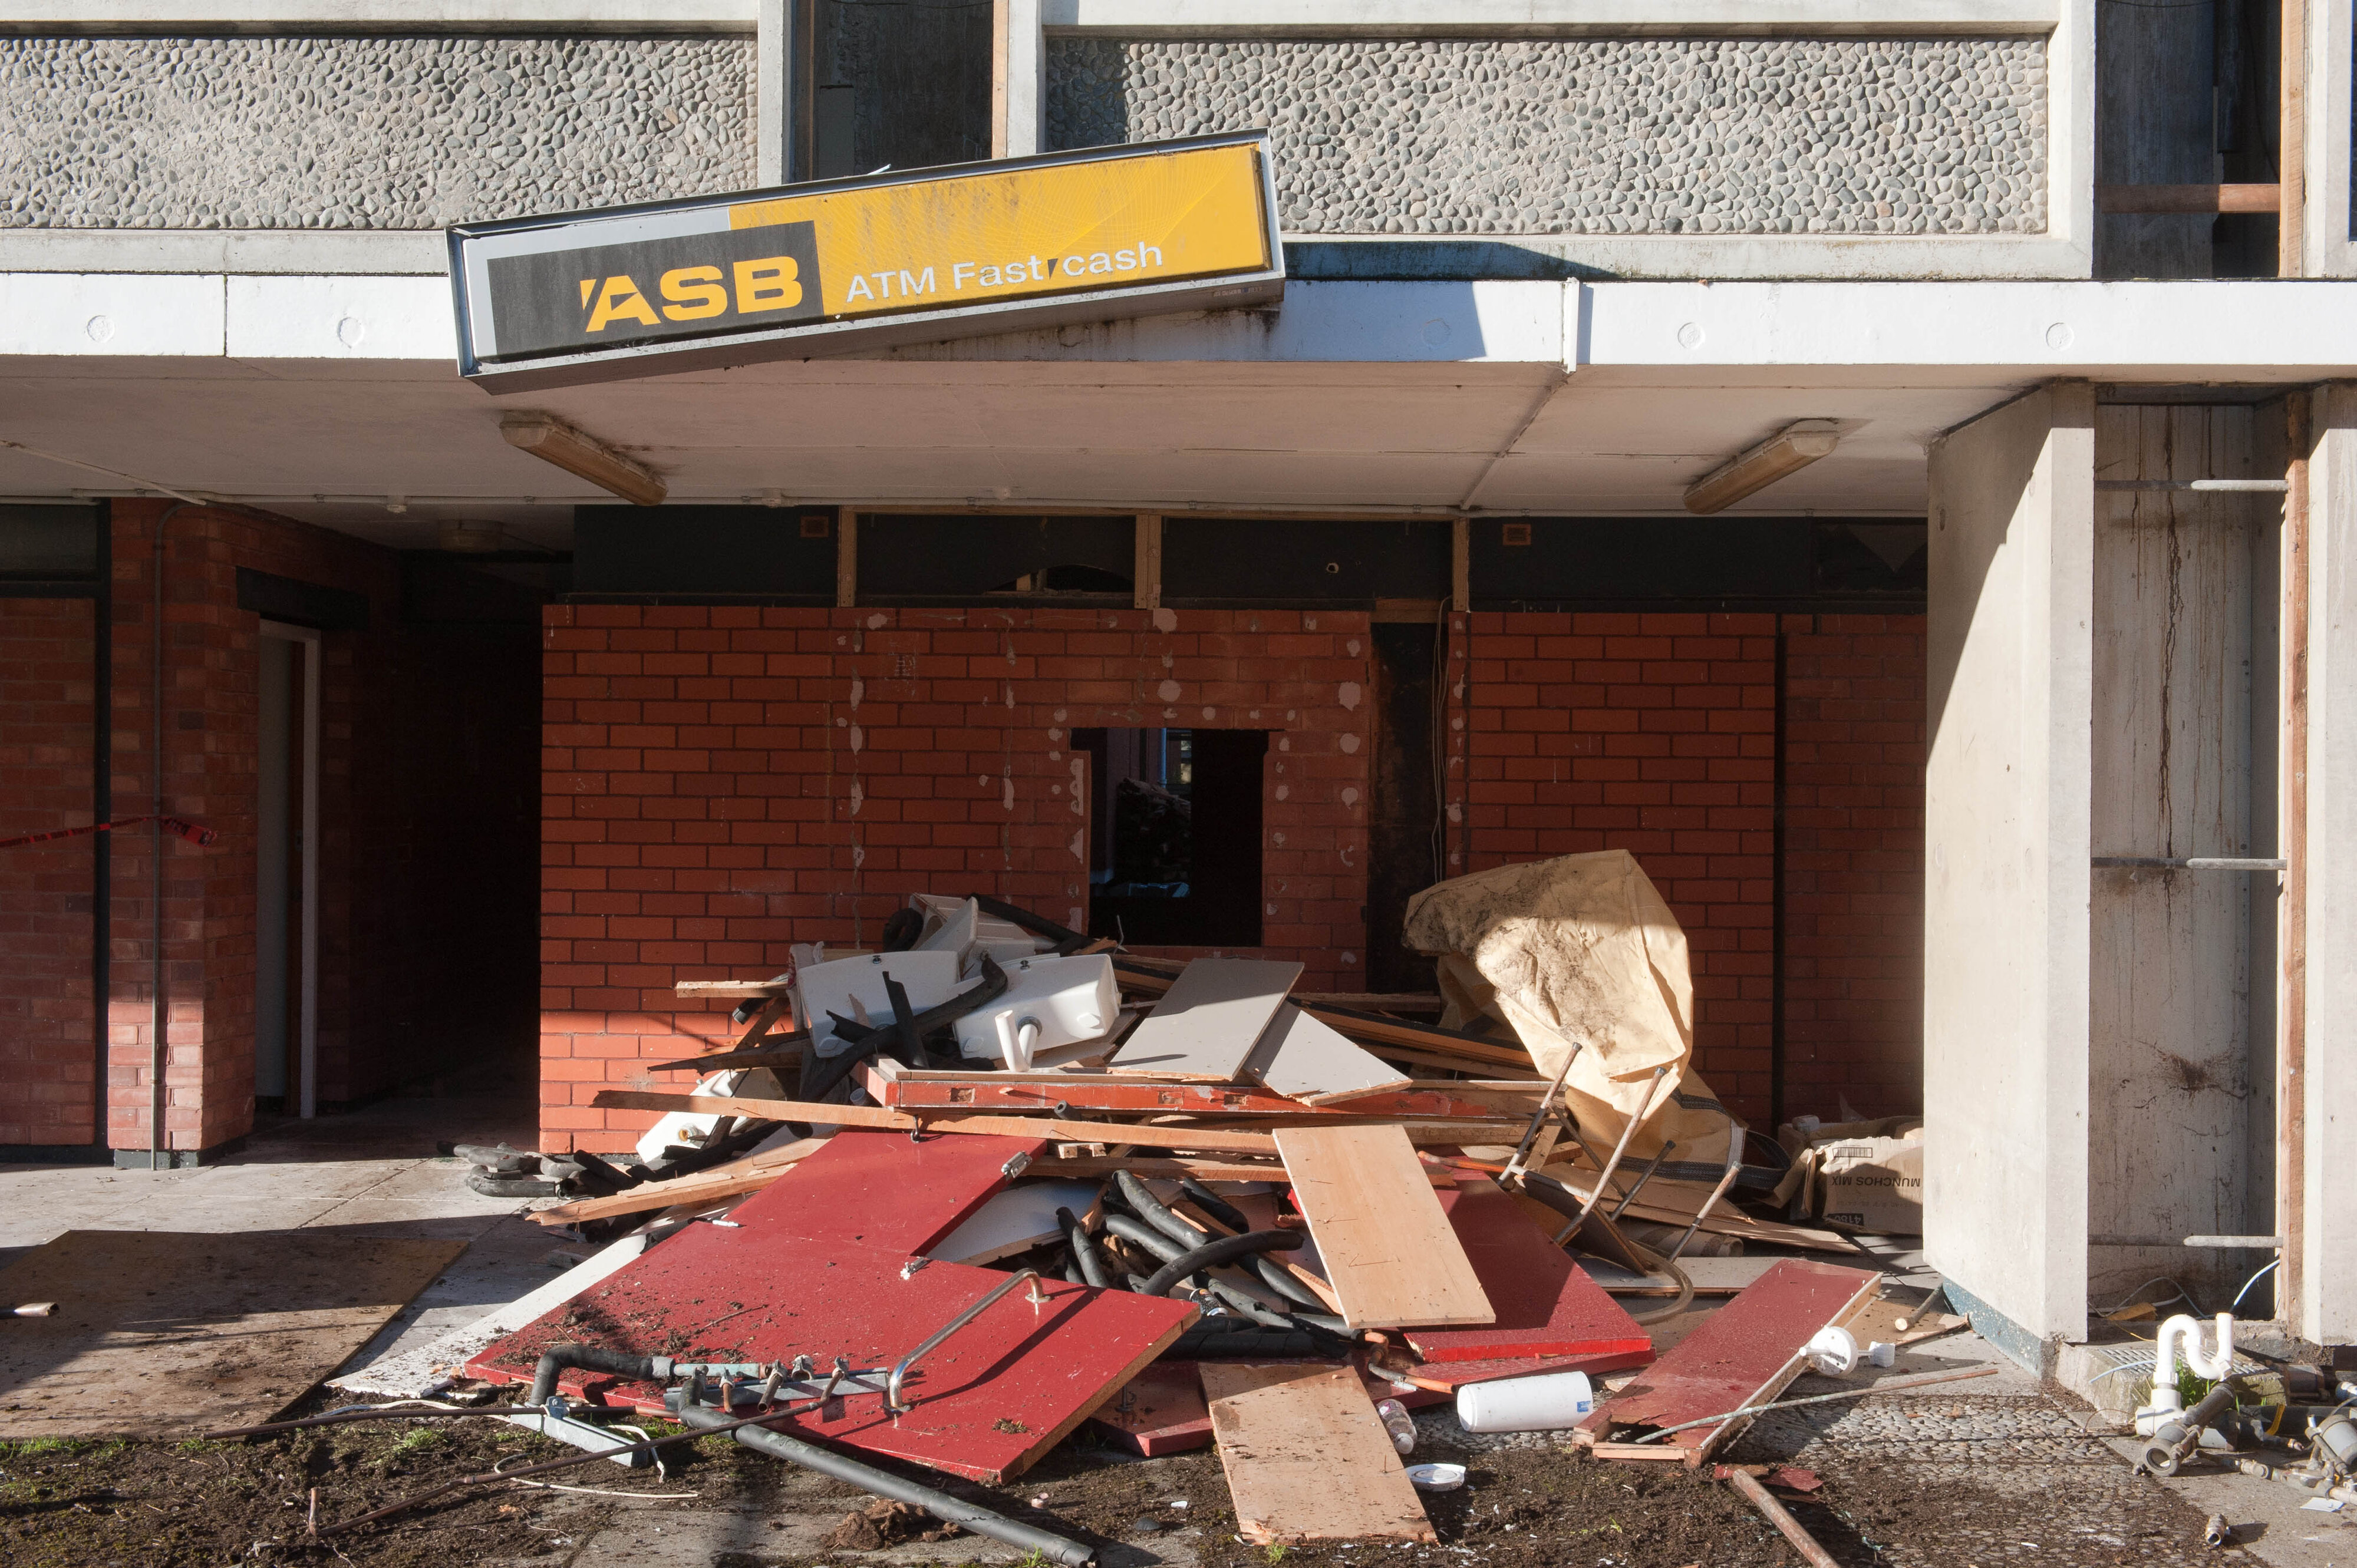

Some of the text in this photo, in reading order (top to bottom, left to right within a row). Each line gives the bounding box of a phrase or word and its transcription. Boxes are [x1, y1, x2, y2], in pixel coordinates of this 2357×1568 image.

[580, 256, 803, 332] ASB
[846, 241, 1163, 303] ATM Fast cash
[1832, 1176, 1920, 1187] MUNCHOS MIX
